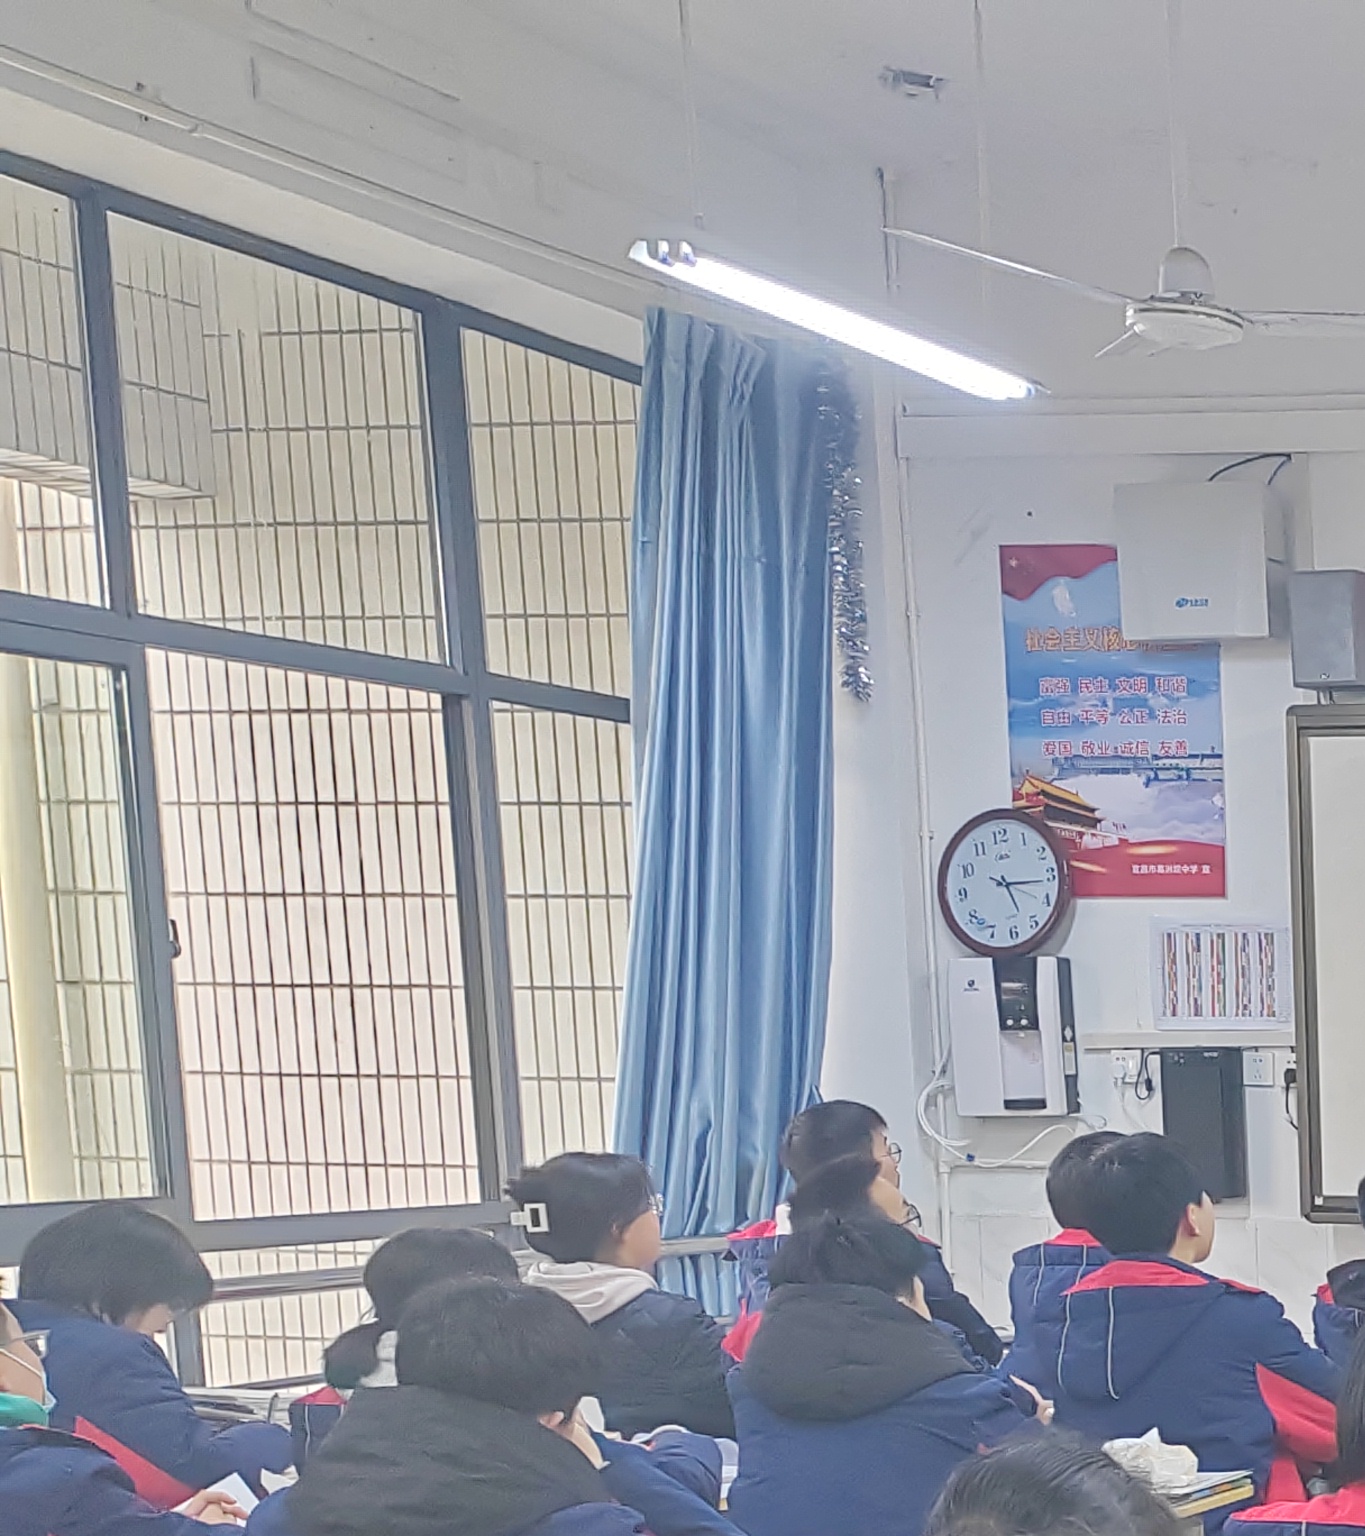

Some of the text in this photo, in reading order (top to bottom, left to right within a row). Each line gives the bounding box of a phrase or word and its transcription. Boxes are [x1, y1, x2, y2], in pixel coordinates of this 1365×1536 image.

[1040, 677, 1187, 695] 富强 民主 文明 和谐
[1042, 709, 1188, 725] 自由 平等 公正 法治
[1043, 740, 1188, 757] 爱国 敬业 诚信 友善
[992, 828, 1009, 845] 12
[1020, 832, 1027, 847] 1
[974, 841, 986, 857] 11
[1036, 846, 1047, 861] 2
[961, 862, 975, 879] 10
[1046, 867, 1056, 882] 3
[958, 887, 968, 902] 9
[1042, 892, 1051, 907] 4
[1029, 914, 1039, 930] 5
[1009, 925, 1019, 940] 6
